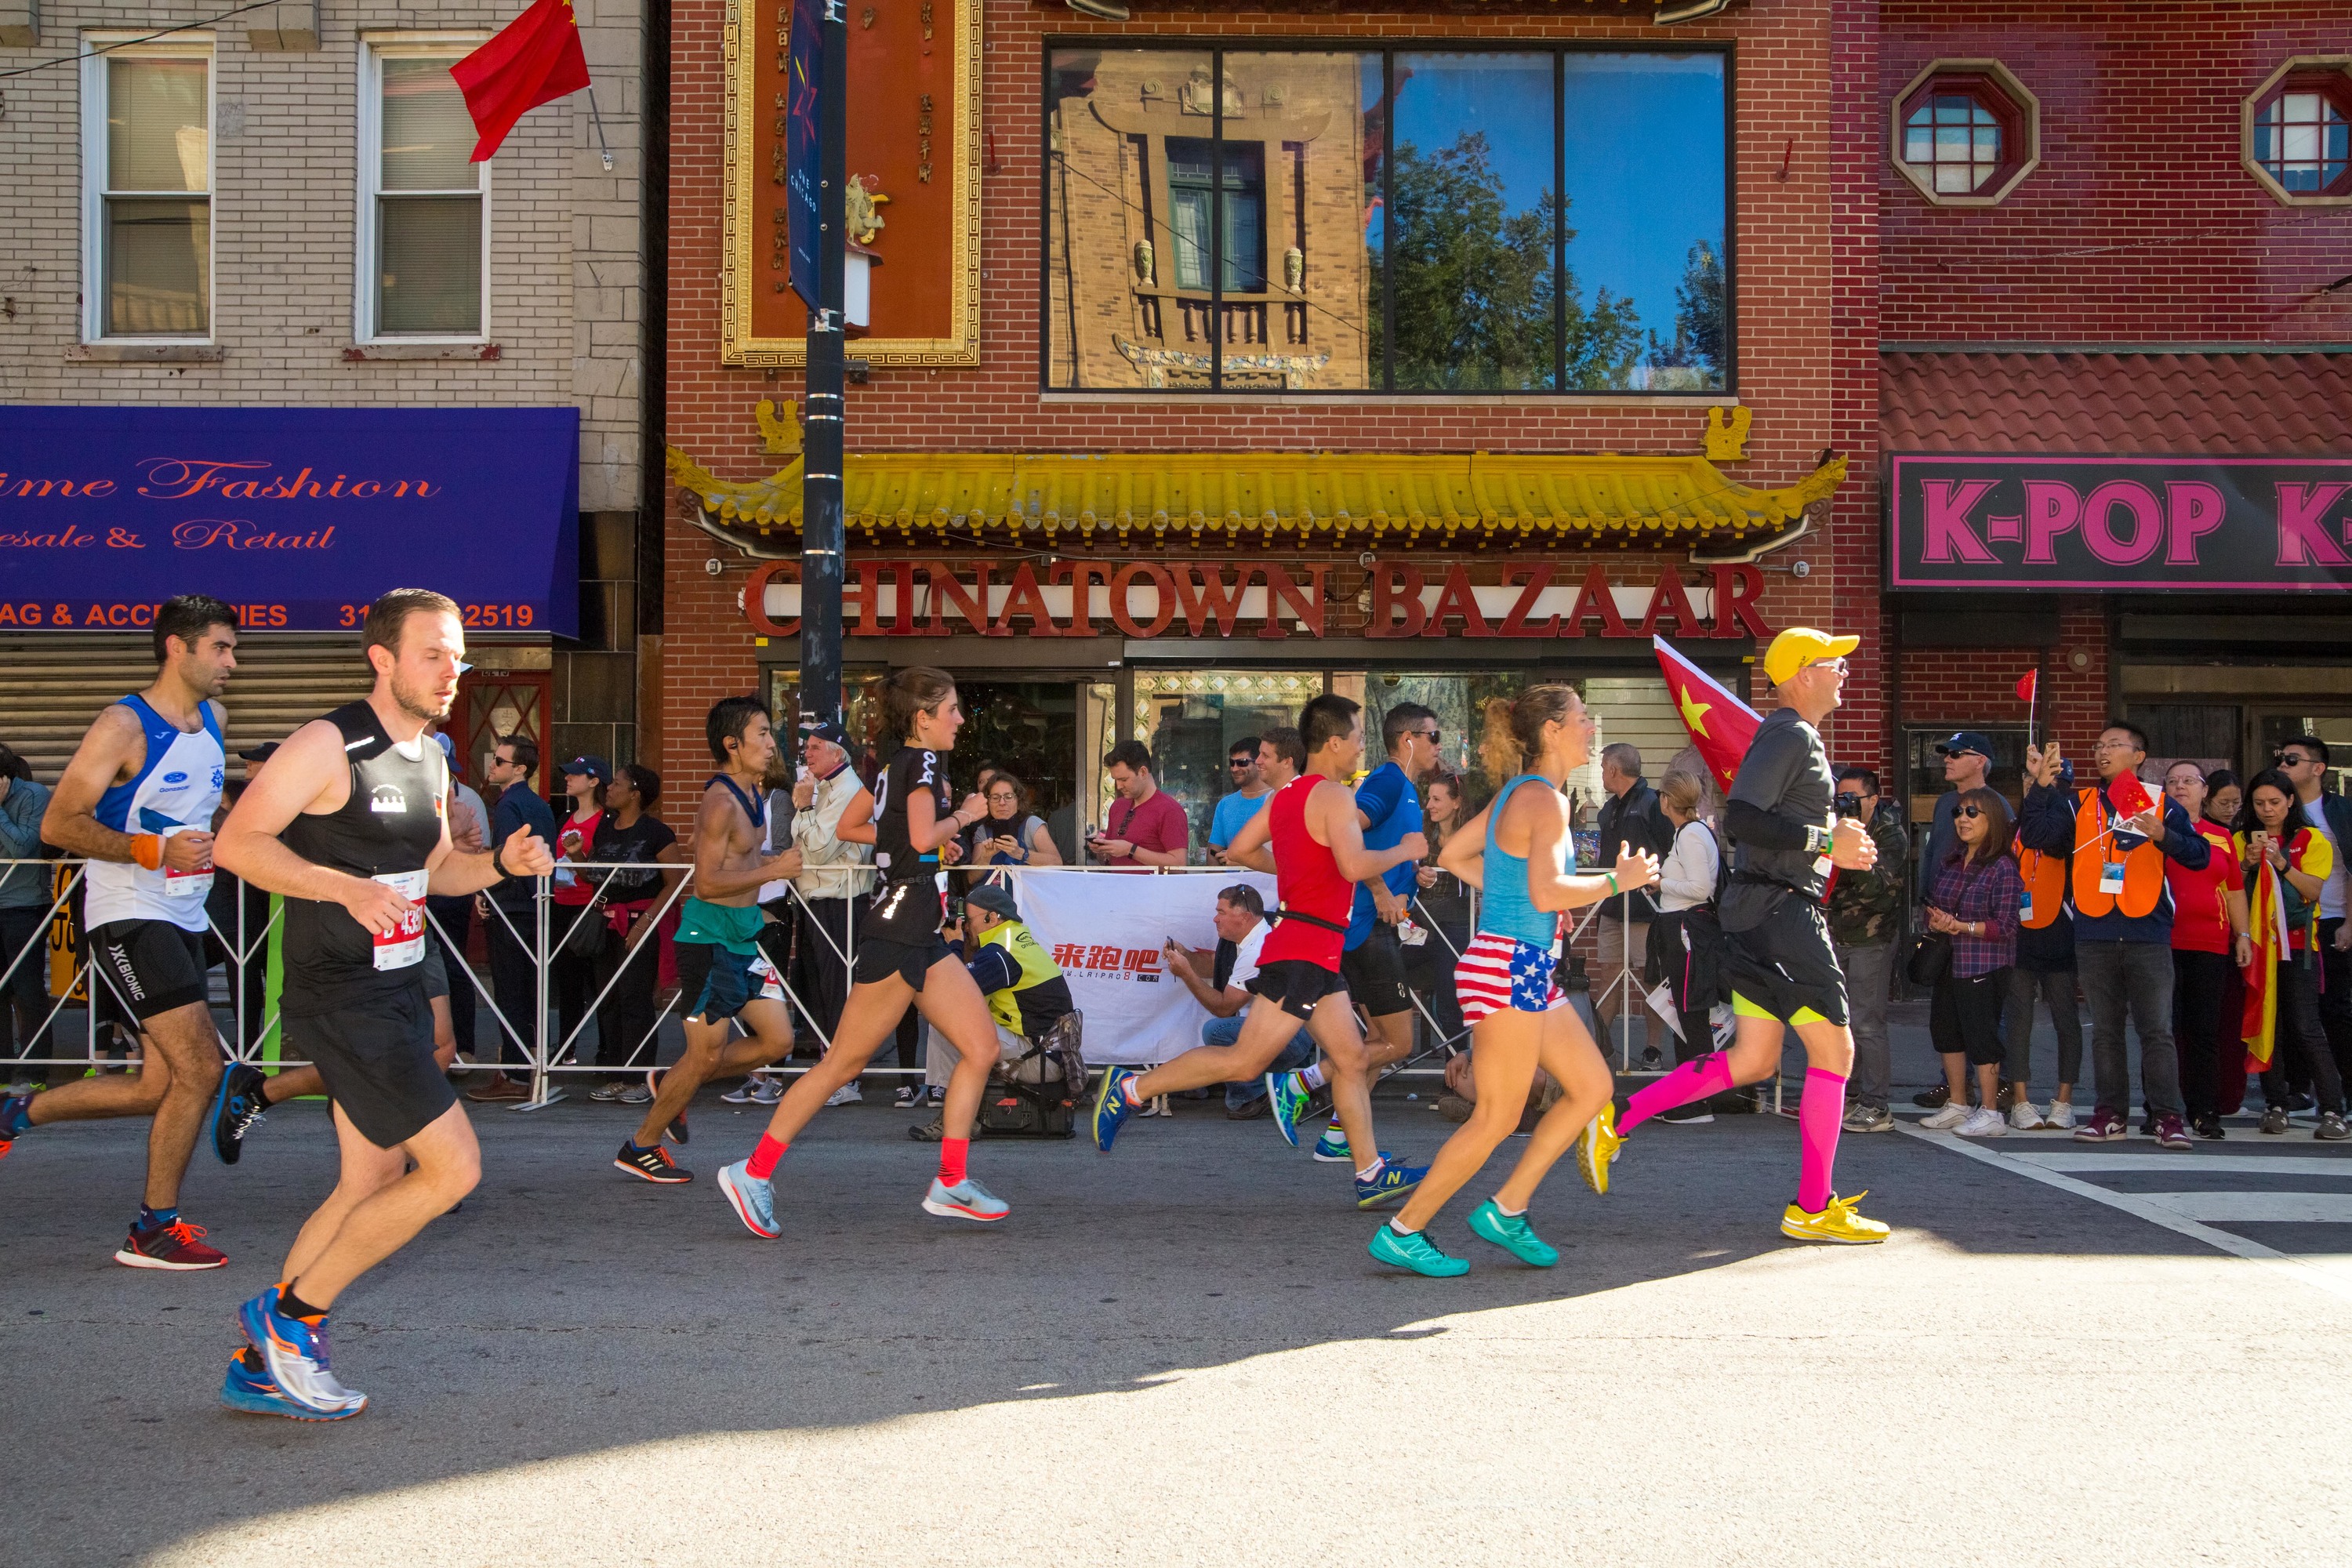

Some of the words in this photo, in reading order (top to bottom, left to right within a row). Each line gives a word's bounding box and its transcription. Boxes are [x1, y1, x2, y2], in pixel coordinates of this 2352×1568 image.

[790, 174, 817, 212] CHICAGO
[798, 169, 810, 190] ONE
[136, 457, 441, 499] Fashion
[107, 527, 146, 548] &
[172, 519, 336, 550] Retail
[1920, 478, 2226, 567] K-POP
[52, 604, 73, 626] &
[745, 560, 1332, 638] CHINATOWN
[1365, 561, 1777, 640] BAZAAR
[1051, 943, 1163, 974] 来跑吧
